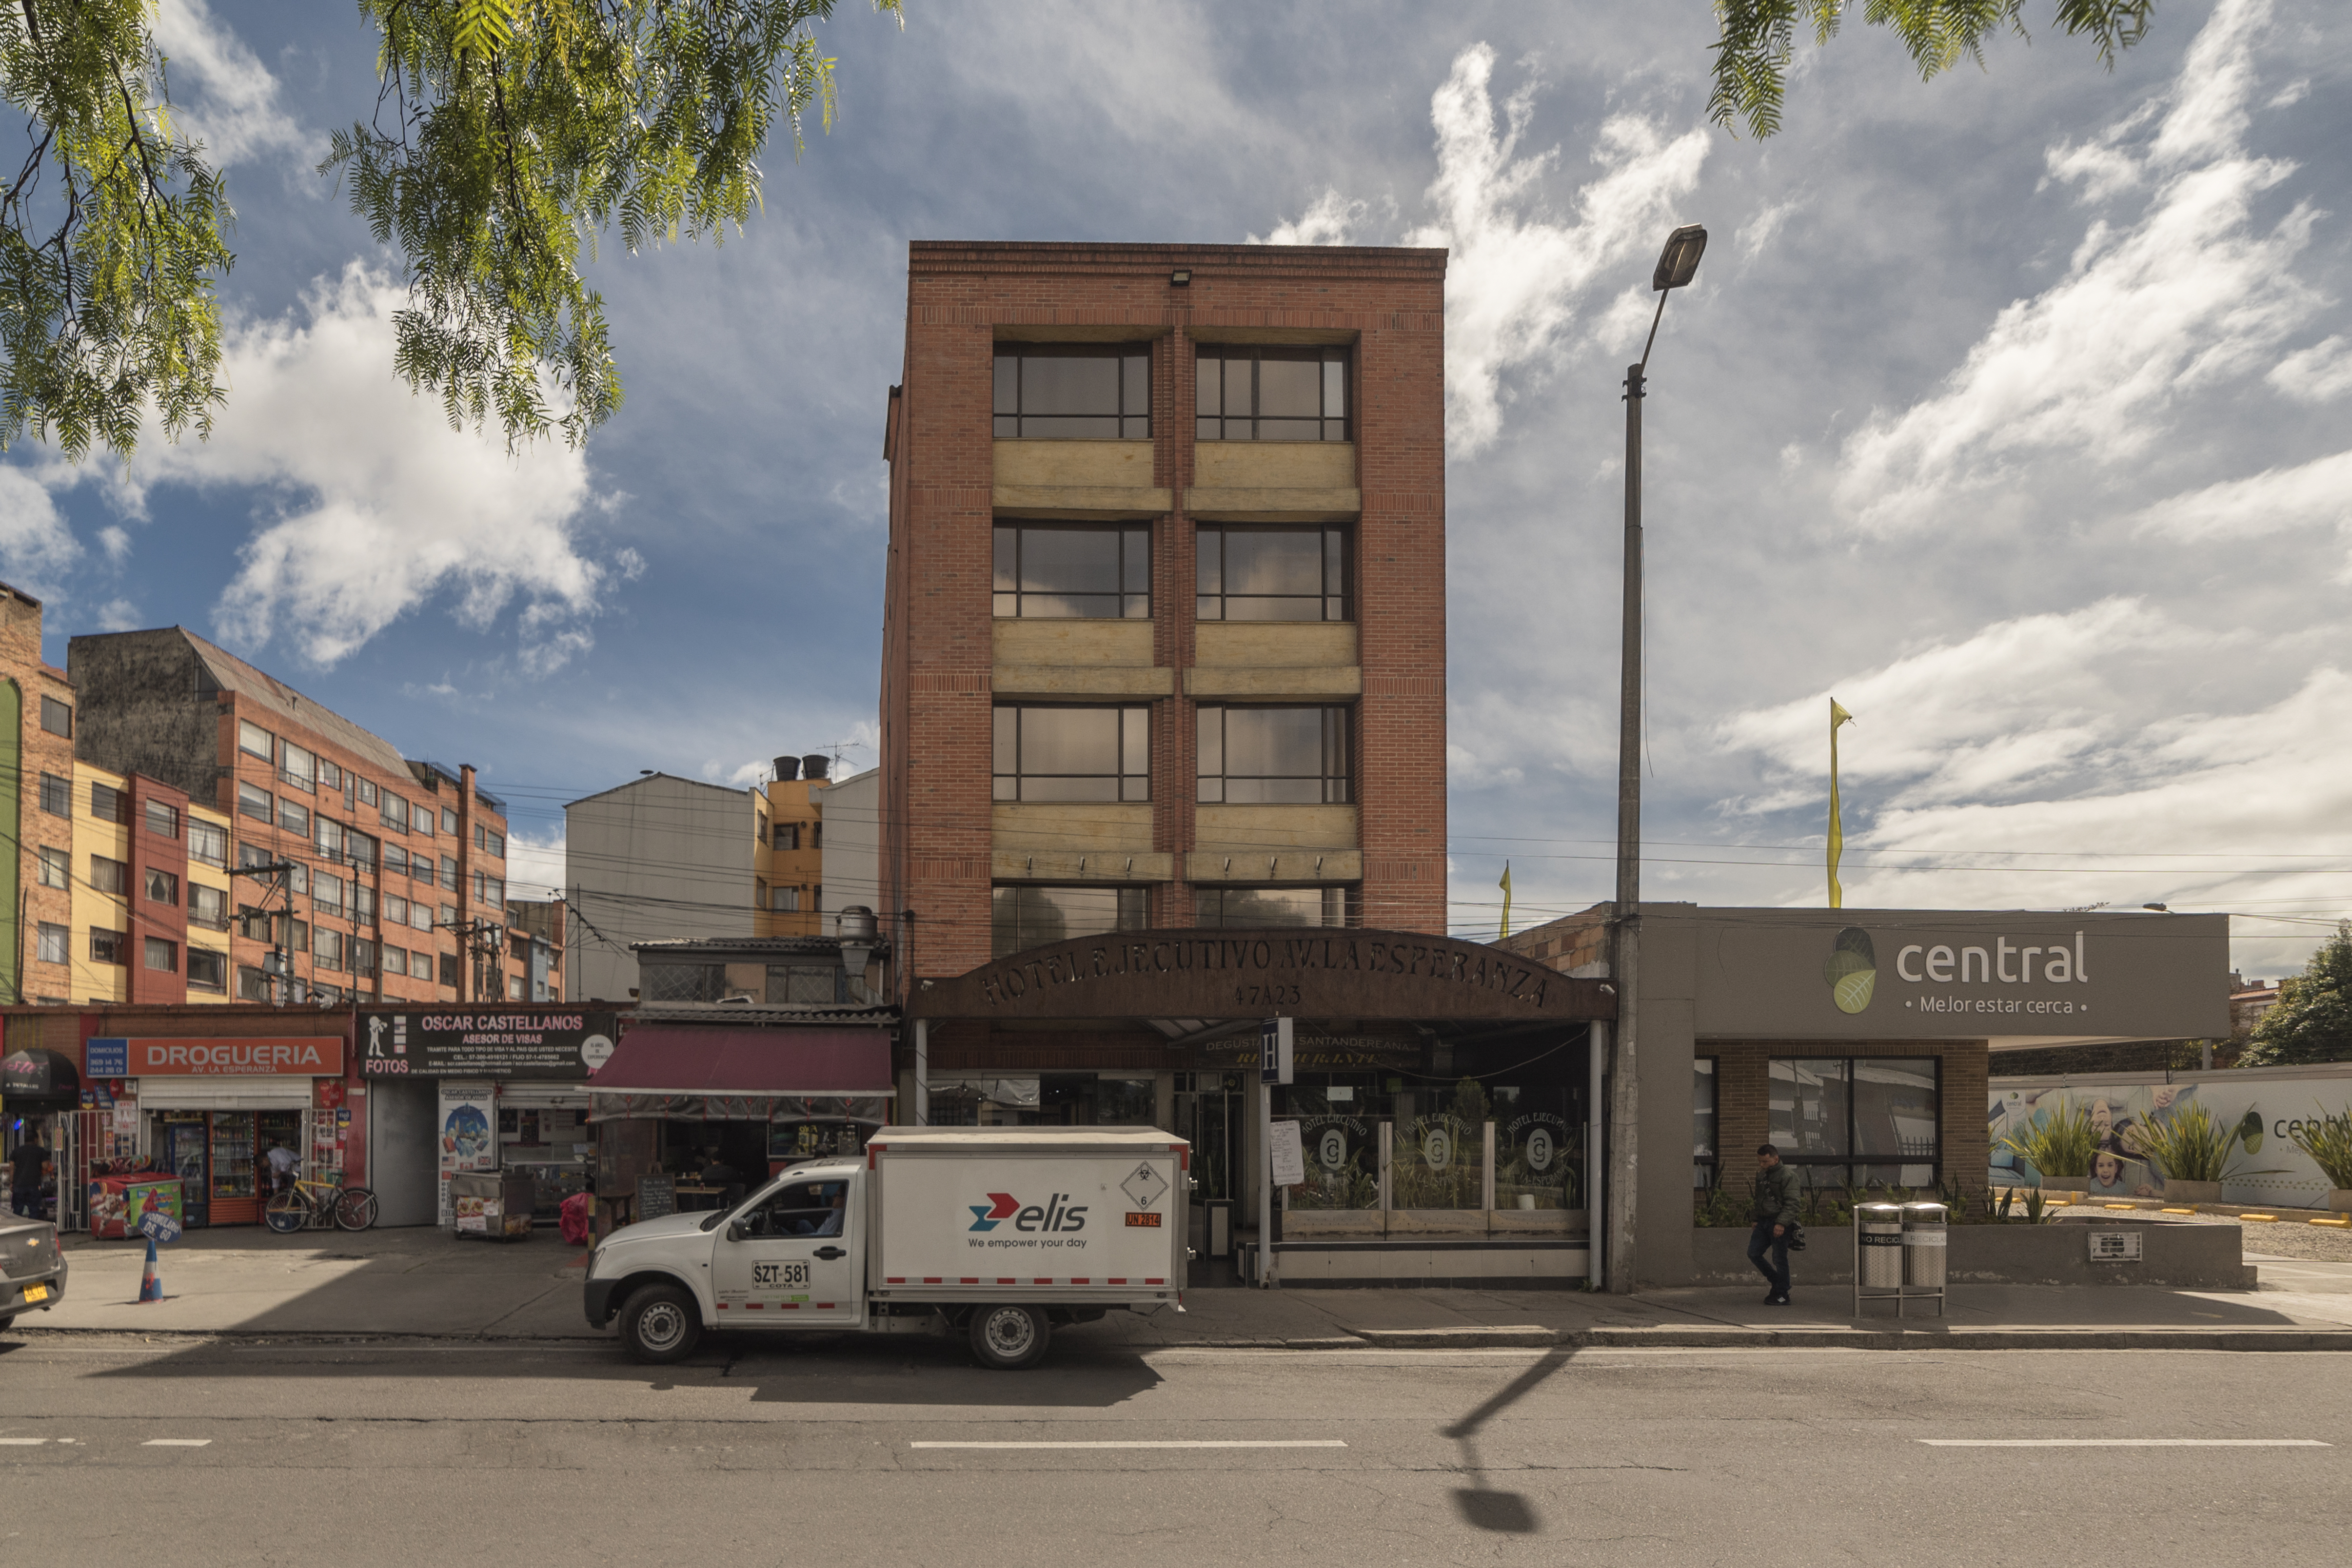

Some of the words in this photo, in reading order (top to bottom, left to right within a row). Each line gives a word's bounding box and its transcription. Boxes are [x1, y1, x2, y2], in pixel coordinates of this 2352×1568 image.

[1896, 930, 2088, 983] central
[982, 952, 1086, 1006] HOTEL
[1092, 939, 1271, 978] EJECUTIVO
[1323, 940, 1361, 970] LA
[1368, 942, 1547, 1008] ESPERANZA
[1975, 998, 2022, 1013] estar
[2026, 1000, 2073, 1014] cerca
[422, 1015, 474, 1031] OSCAR
[477, 1015, 583, 1031] CASTELLANOS
[463, 1034, 500, 1044] ASESOR
[502, 1034, 514, 1044] DE
[516, 1034, 543, 1044] VISAS
[1206, 1037, 1295, 1051] DEGUST
[1299, 1037, 1409, 1051] SANTANDEREANA
[148, 1045, 322, 1065] DROGUERIA
[1237, 1053, 1381, 1064] REURANTE
[1263, 1033, 1278, 1071] H
[366, 1059, 409, 1073] FOTOS
[1302, 1115, 1325, 1135] HOTEL
[1327, 1114, 1367, 1136] EJECUTIVO
[1404, 1114, 1430, 1135] HOTEL
[1432, 1113, 1472, 1135] EJECUTIVO
[1506, 1114, 1532, 1134] HOTEL
[1533, 1112, 1573, 1134] EJECUTIVO
[2286, 1146, 2307, 1156] Mejo
[1141, 1196, 1147, 1205] 6
[1016, 1193, 1088, 1231] elis
[1127, 1214, 1139, 1225] UN
[1141, 1214, 1160, 1225] 2814
[145, 1212, 179, 1234] FORMULARIO
[160, 1229, 172, 1241] 60
[968, 1238, 985, 1248] We
[988, 1239, 1038, 1249] empower
[1040, 1239, 1064, 1249] your
[1067, 1238, 1087, 1249] day
